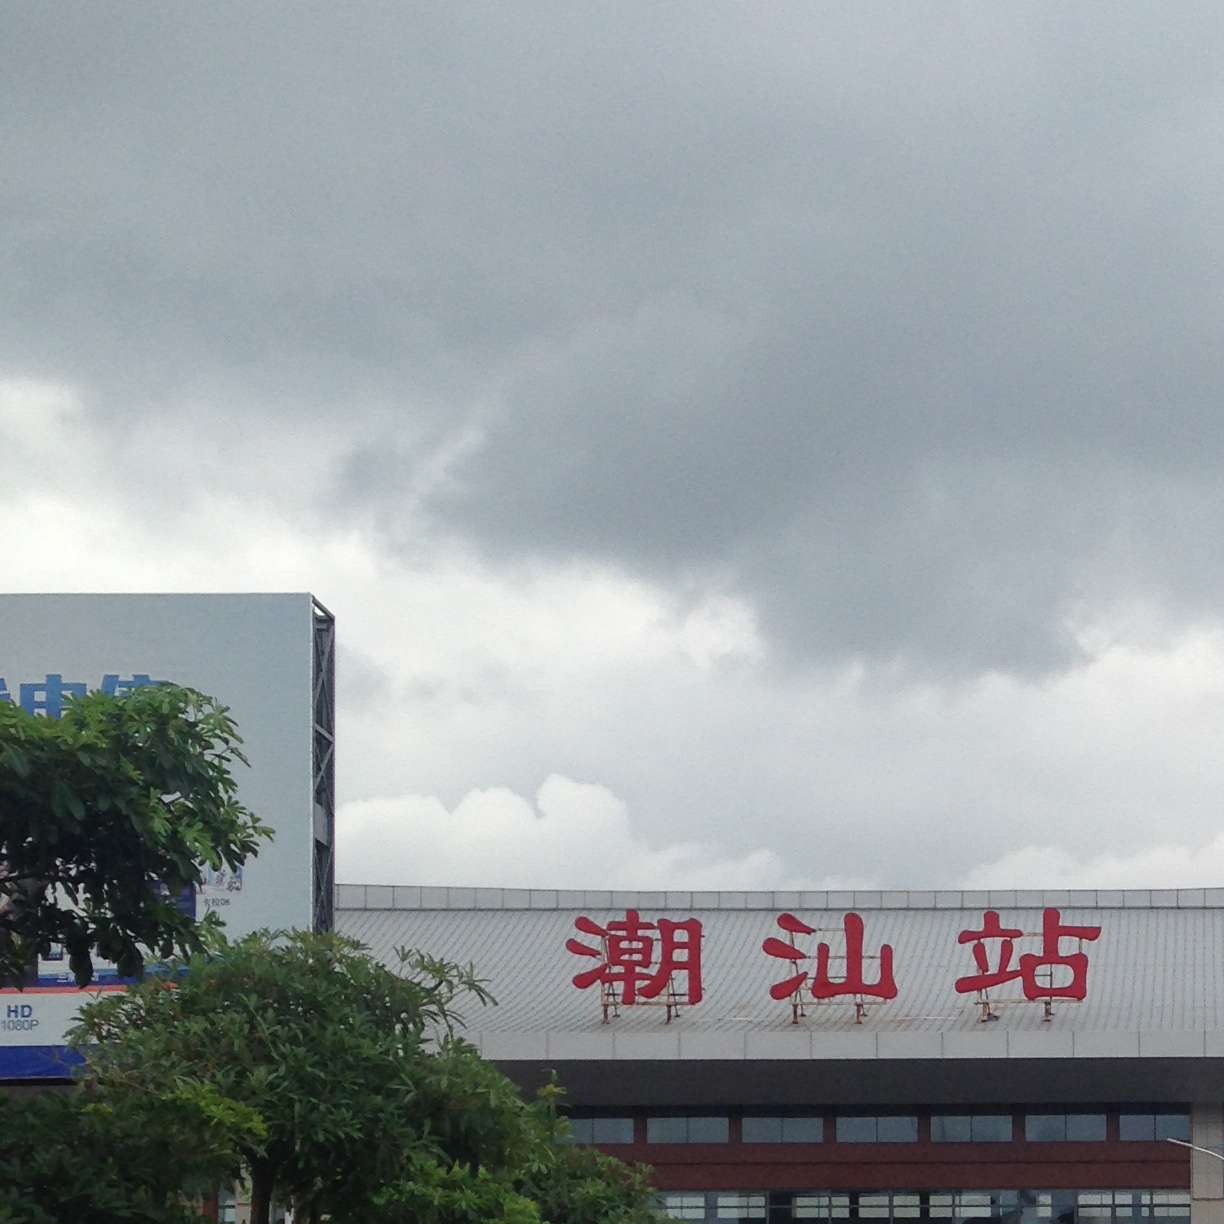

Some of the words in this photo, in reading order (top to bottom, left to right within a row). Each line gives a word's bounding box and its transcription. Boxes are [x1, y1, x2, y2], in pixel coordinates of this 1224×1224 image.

[566, 908, 1102, 1004] 潮汕站
[7, 1005, 33, 1018] HD
[2, 1020, 39, 1031] 1080P
